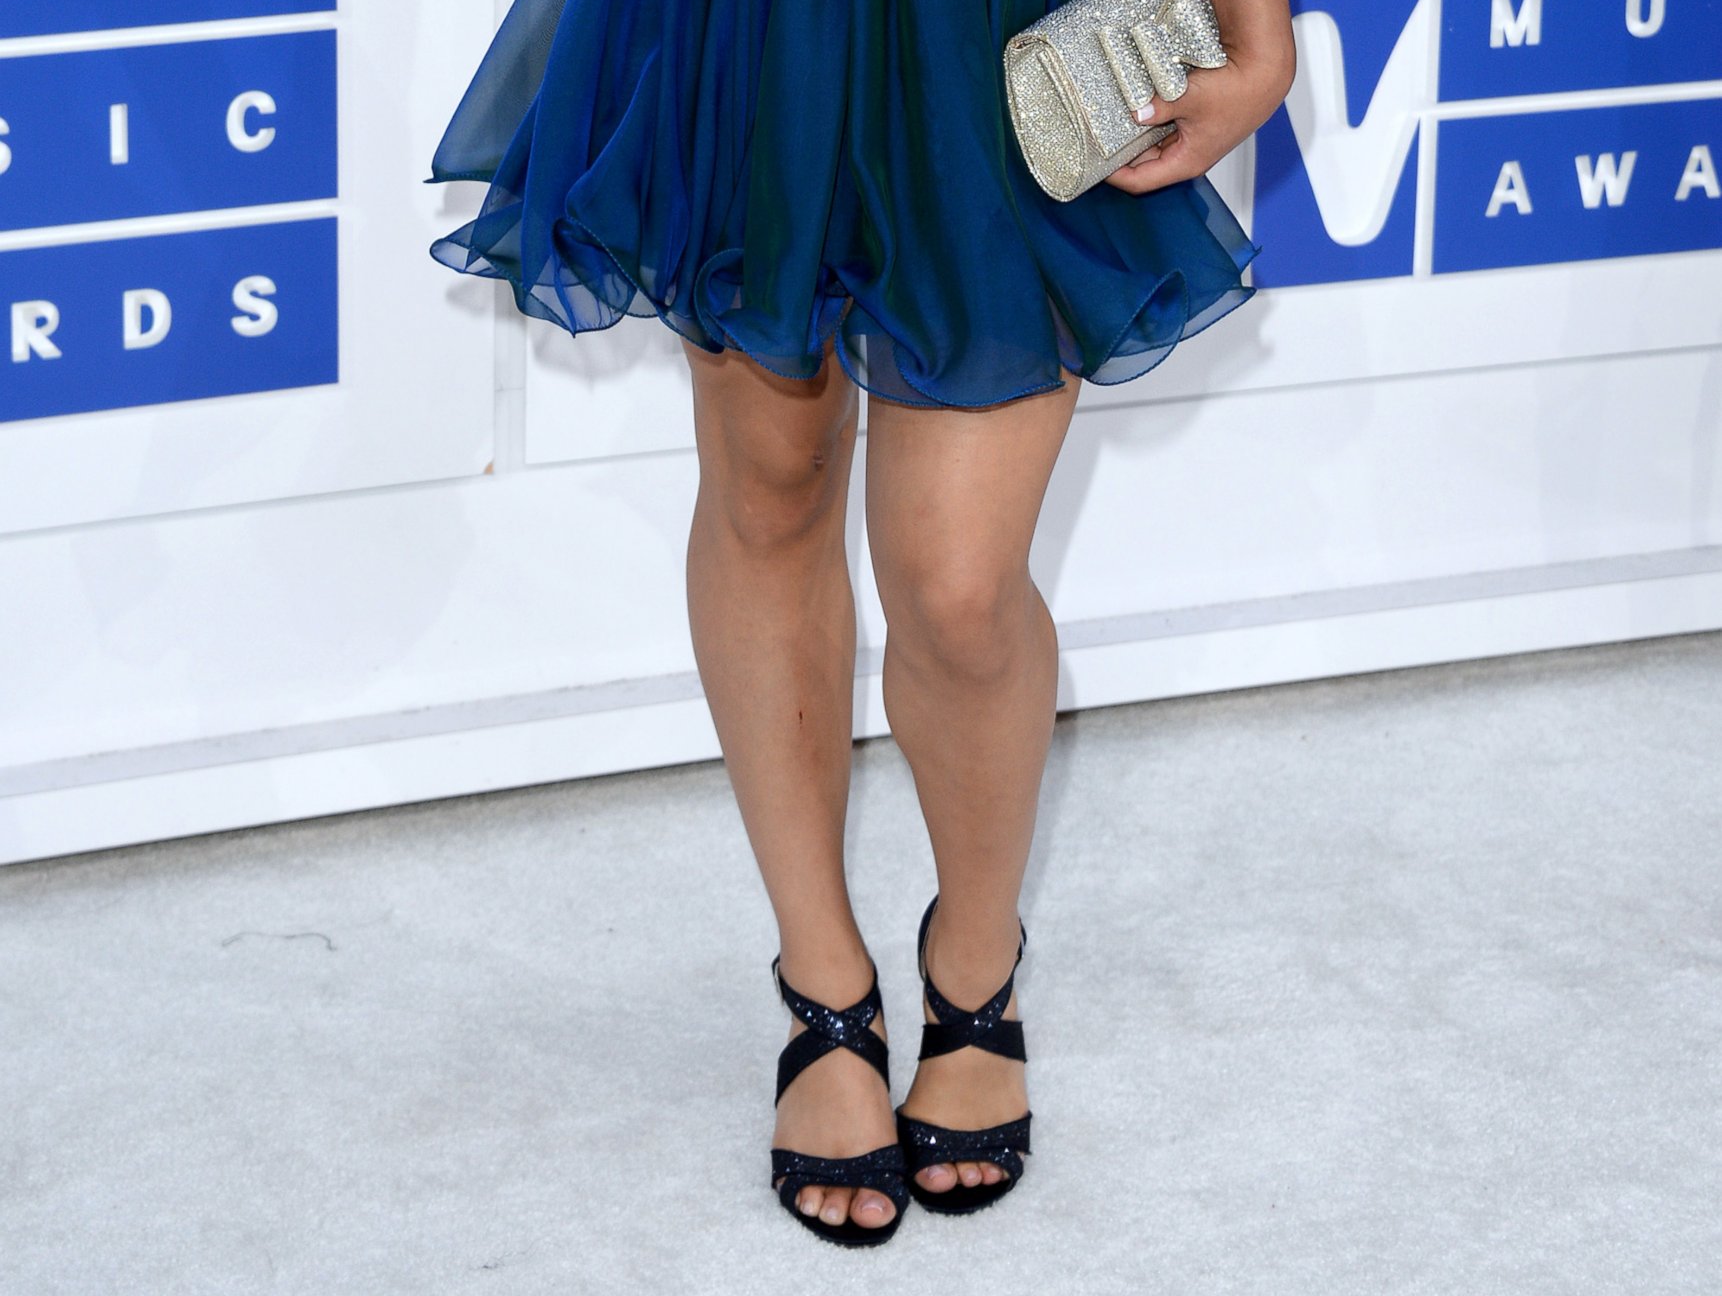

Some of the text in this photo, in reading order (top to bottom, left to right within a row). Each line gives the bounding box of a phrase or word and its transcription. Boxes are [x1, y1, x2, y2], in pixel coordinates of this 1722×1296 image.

[0, 90, 276, 176] IC
[1485, 145, 1722, 218] AWA
[11, 275, 278, 363] RDS
